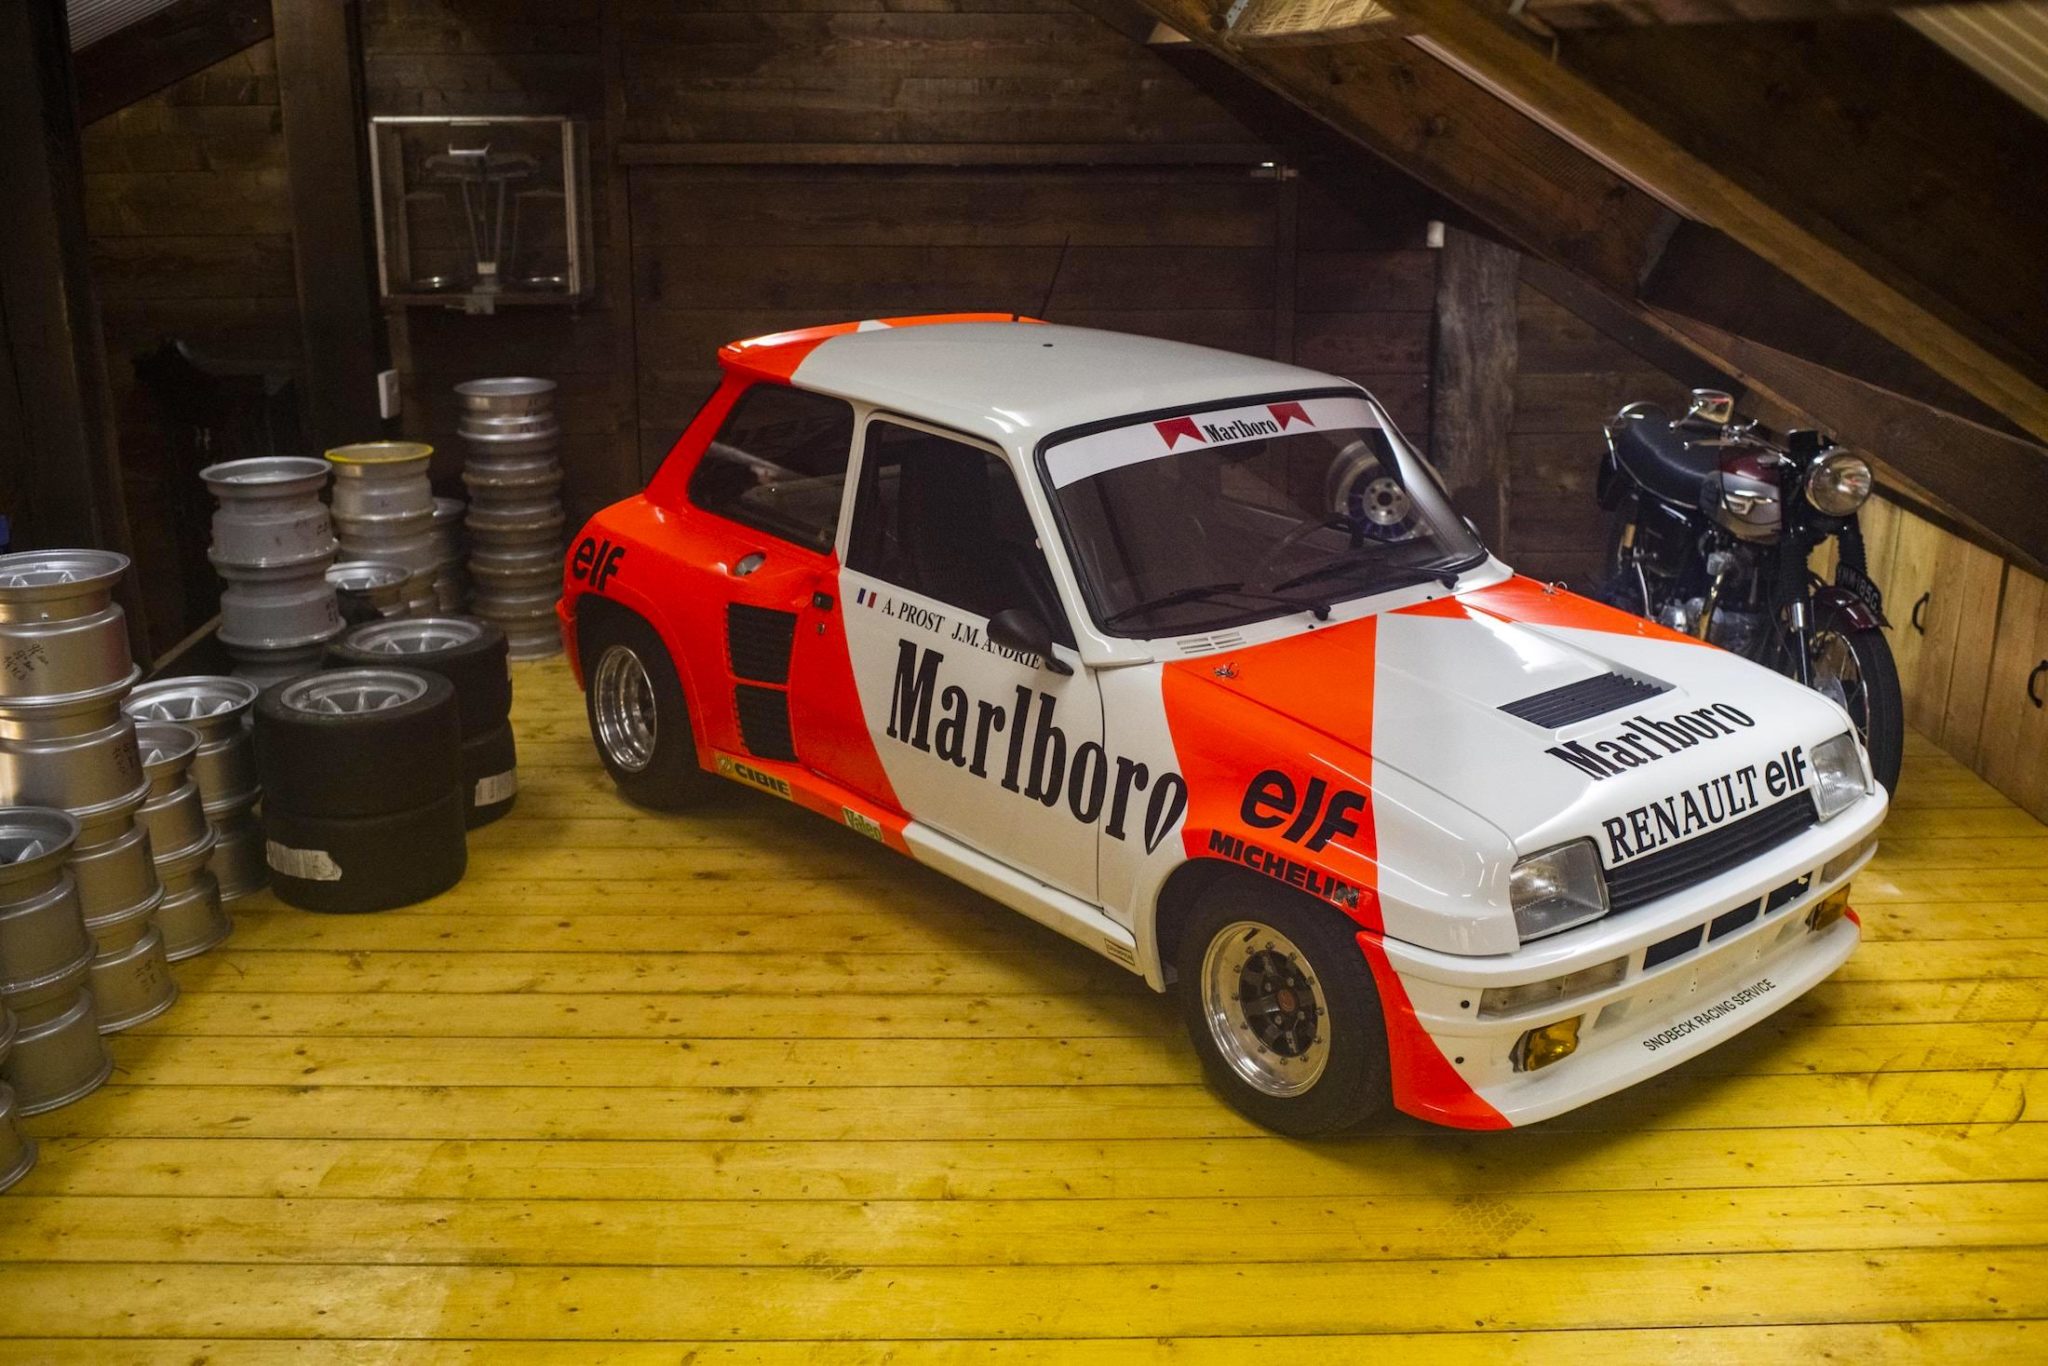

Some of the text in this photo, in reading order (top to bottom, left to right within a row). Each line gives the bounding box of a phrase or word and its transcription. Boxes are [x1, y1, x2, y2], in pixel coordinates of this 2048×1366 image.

[1203, 419, 1278, 443] Marlboro
[572, 537, 625, 591] elf
[882, 598, 894, 616] A.
[899, 602, 946, 633] PROST
[952, 623, 979, 648] J.M.
[886, 638, 1188, 855] Marlboro
[1545, 703, 1755, 781] Marlboro
[1240, 769, 1367, 854] elf
[1602, 745, 1806, 864] RENAULT elf
[1208, 829, 1360, 909] MICHELIN
[1643, 978, 1777, 1051] SNOBECK RACING SERVICE
